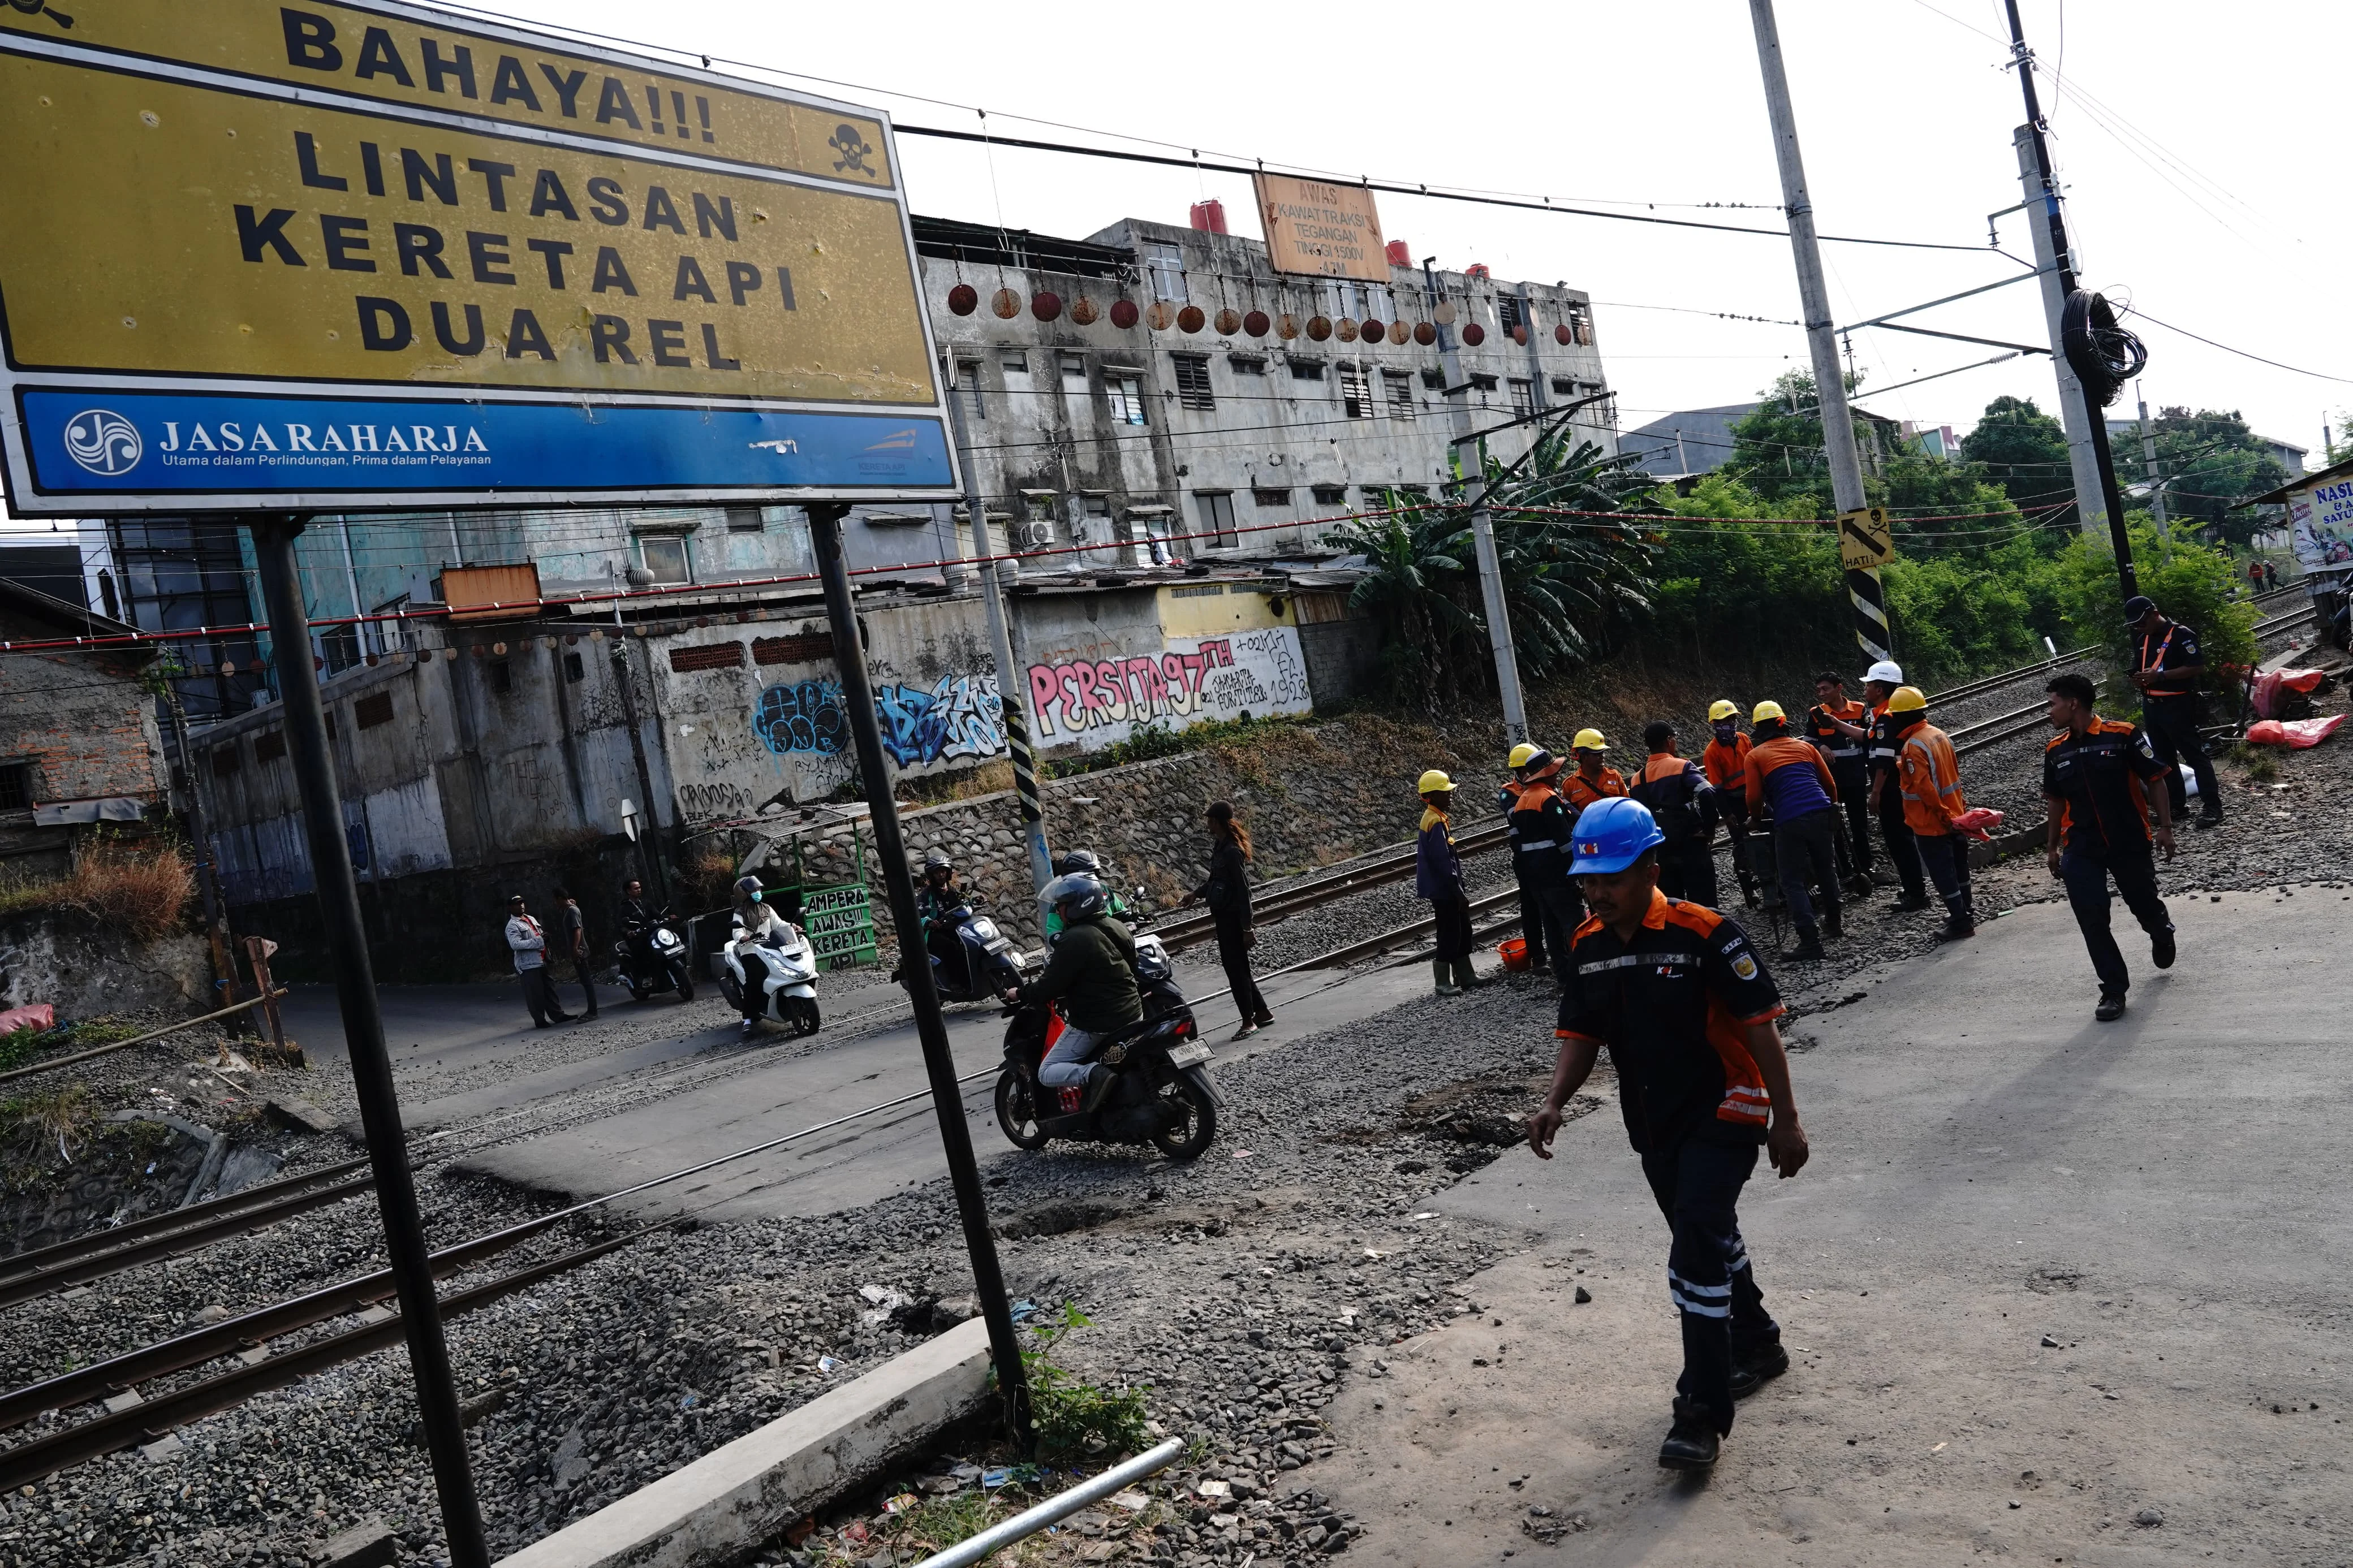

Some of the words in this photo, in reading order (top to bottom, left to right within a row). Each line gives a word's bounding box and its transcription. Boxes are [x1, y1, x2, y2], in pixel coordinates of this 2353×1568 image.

[281, 7, 714, 144] BAHAYA!!!
[294, 131, 739, 241] LINTASAN
[1299, 182, 1338, 205] AWAS
[1278, 203, 1320, 222] KAWAT
[1322, 209, 1365, 227] TRAKSI
[1294, 223, 1358, 244] TEGANGAN
[234, 204, 639, 297] KERETA
[674, 256, 796, 311] API
[1294, 240, 1333, 258] TINGGI
[1334, 247, 1364, 261] 1500V
[355, 296, 557, 361] DUA
[590, 314, 742, 371] REL
[160, 422, 281, 451] JASA
[283, 424, 489, 451] RAHARJA
[162, 455, 209, 465] Utama
[213, 455, 255, 465] dalam
[258, 455, 349, 466] Perlindungan,
[352, 455, 388, 465] Prima
[391, 455, 428, 465] dalam
[430, 455, 491, 466] Pelayanan
[2315, 482, 2353, 504] NASI
[2323, 508, 2353, 524] SAYU
[2334, 502, 2342, 511] &
[806, 888, 865, 914] AMPERA
[812, 908, 864, 935] AWAS!!!
[811, 929, 869, 956] KERETA
[829, 952, 858, 971] API
